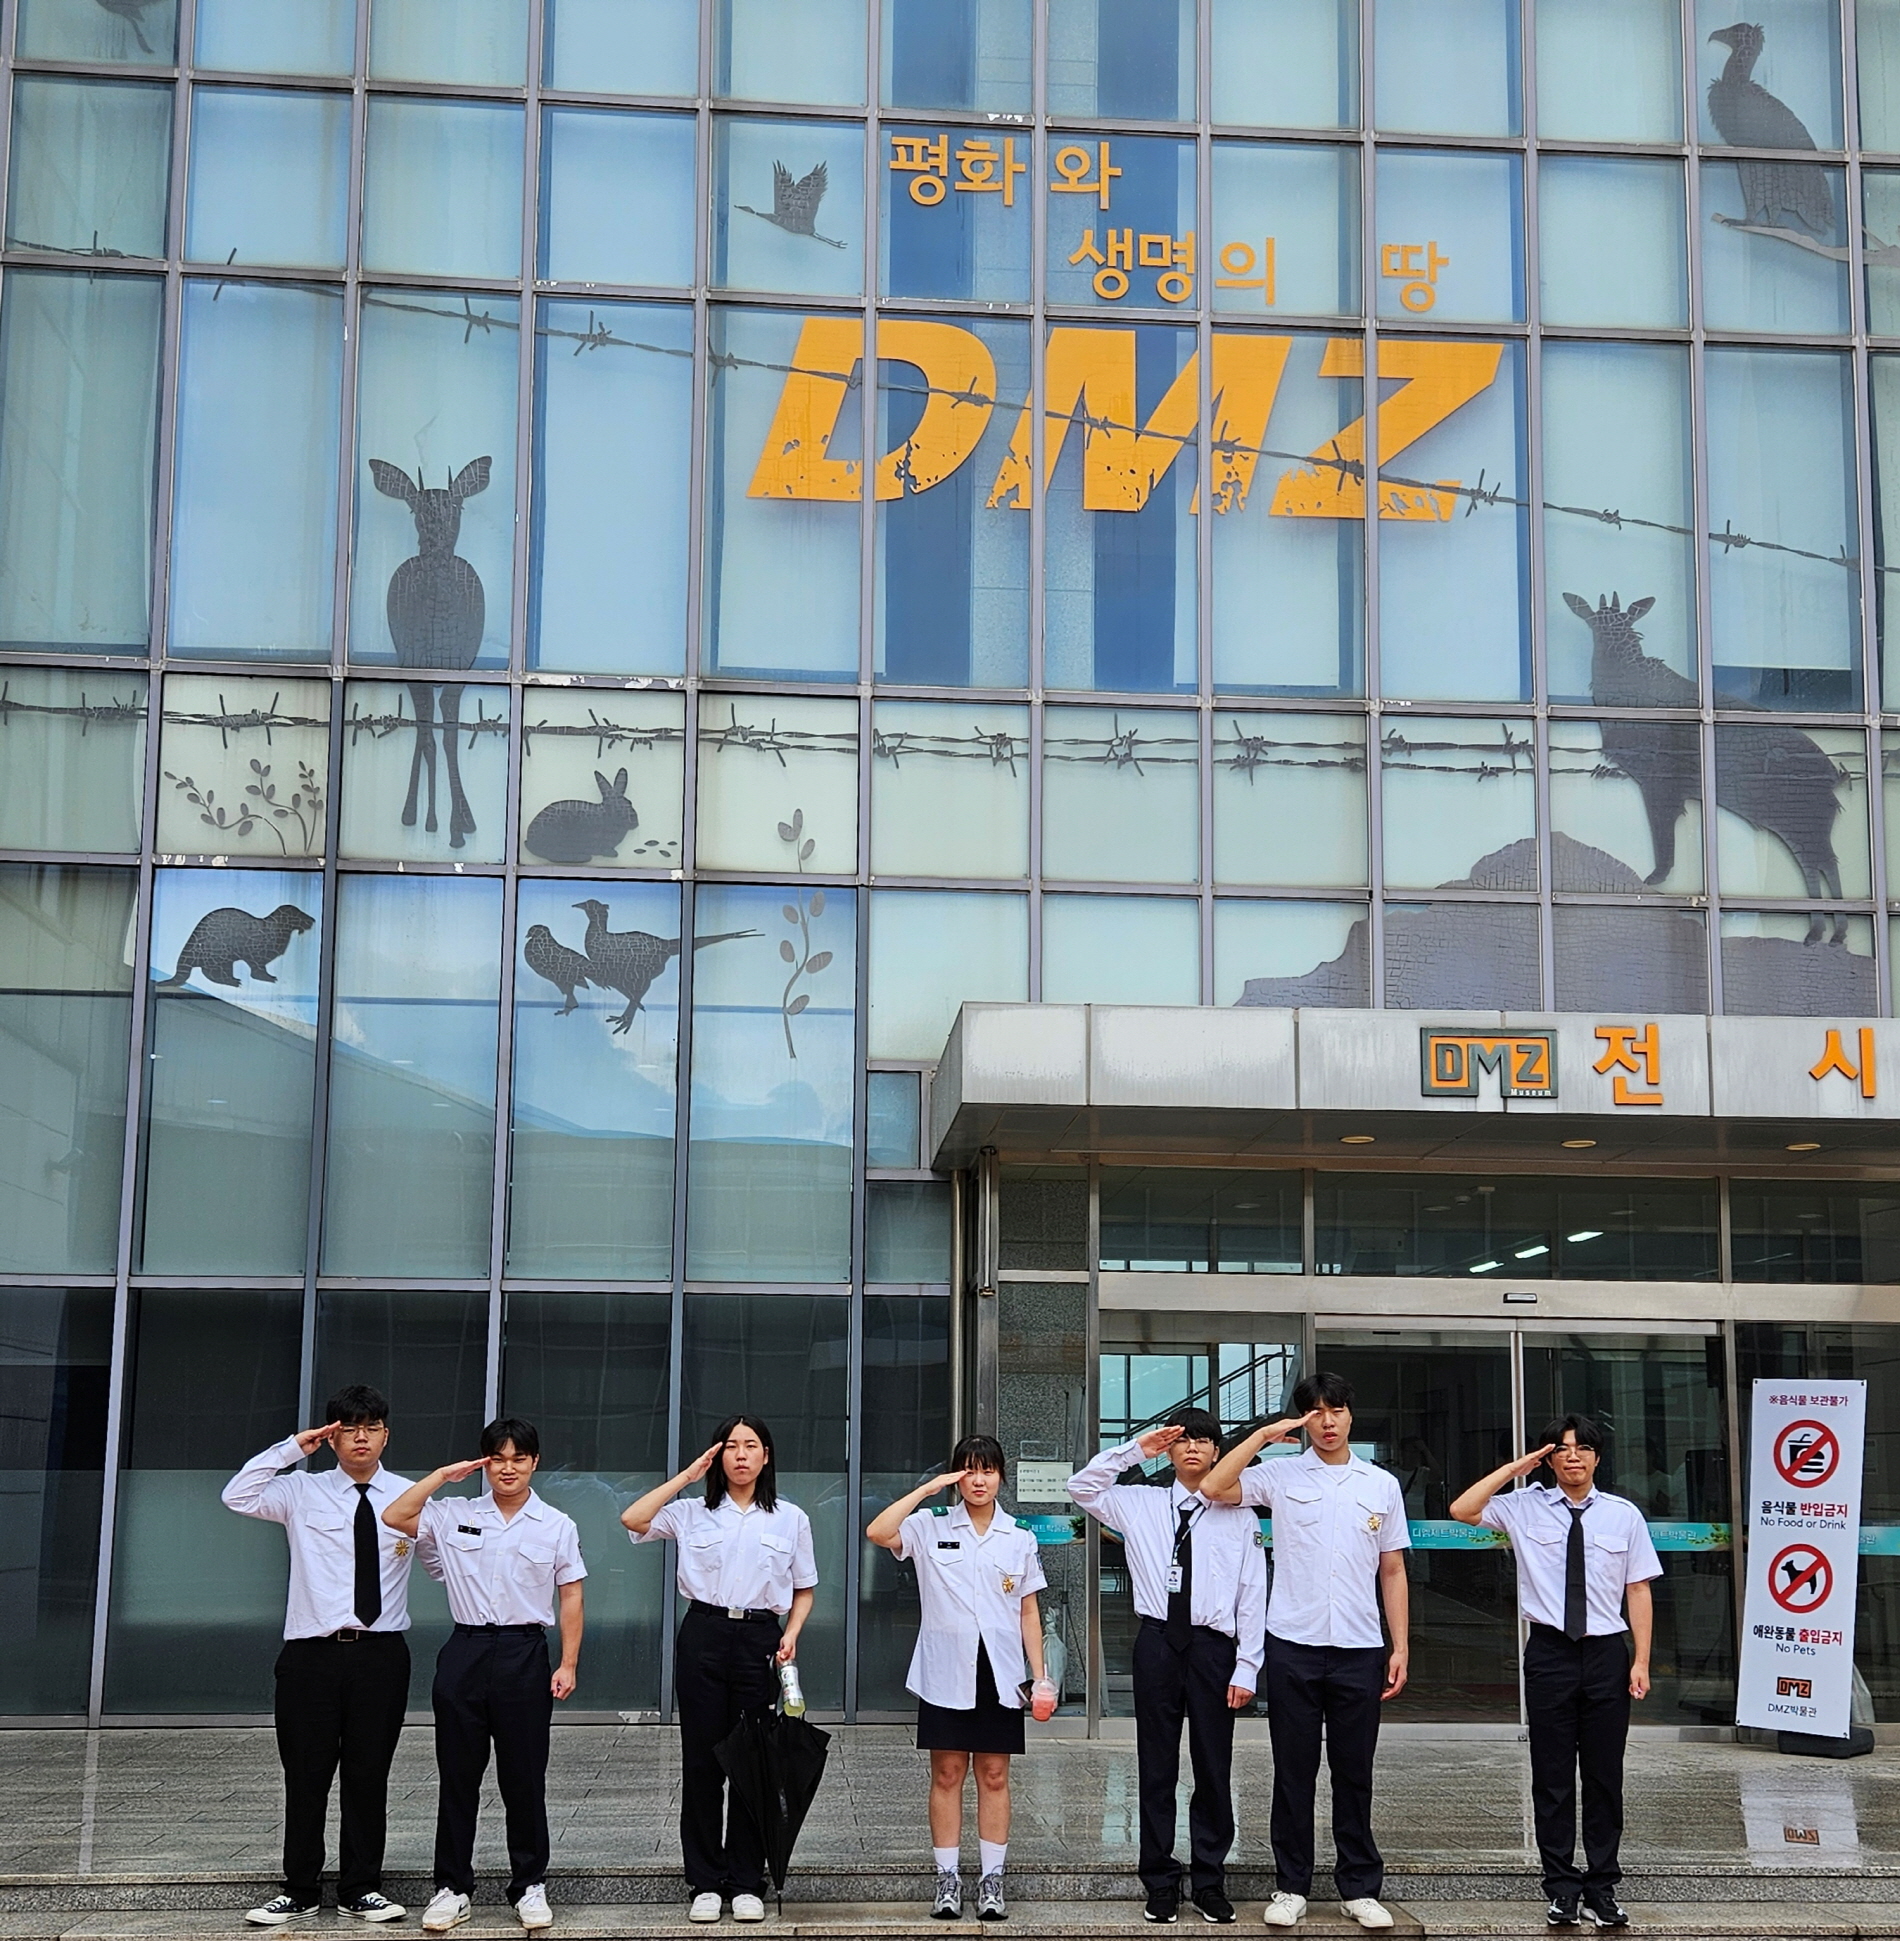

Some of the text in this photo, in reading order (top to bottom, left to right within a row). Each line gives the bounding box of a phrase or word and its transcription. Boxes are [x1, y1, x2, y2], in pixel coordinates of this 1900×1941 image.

[1381, 241, 1450, 313] 땅
[746, 316, 1505, 522] DMZ
[1435, 1038, 1545, 1097] DMZ
[1510, 1088, 1552, 1096] Museum
[1761, 1501, 1848, 1518] 음식물 반입금지
[1760, 1517, 1847, 1530] No Food or Drink
[1753, 1624, 1843, 1646] 애완동물 출입금지
[1775, 1643, 1816, 1656] No Pets
[1778, 1680, 1810, 1697] DMZ
[1767, 1703, 1817, 1718] DMZ박물관
